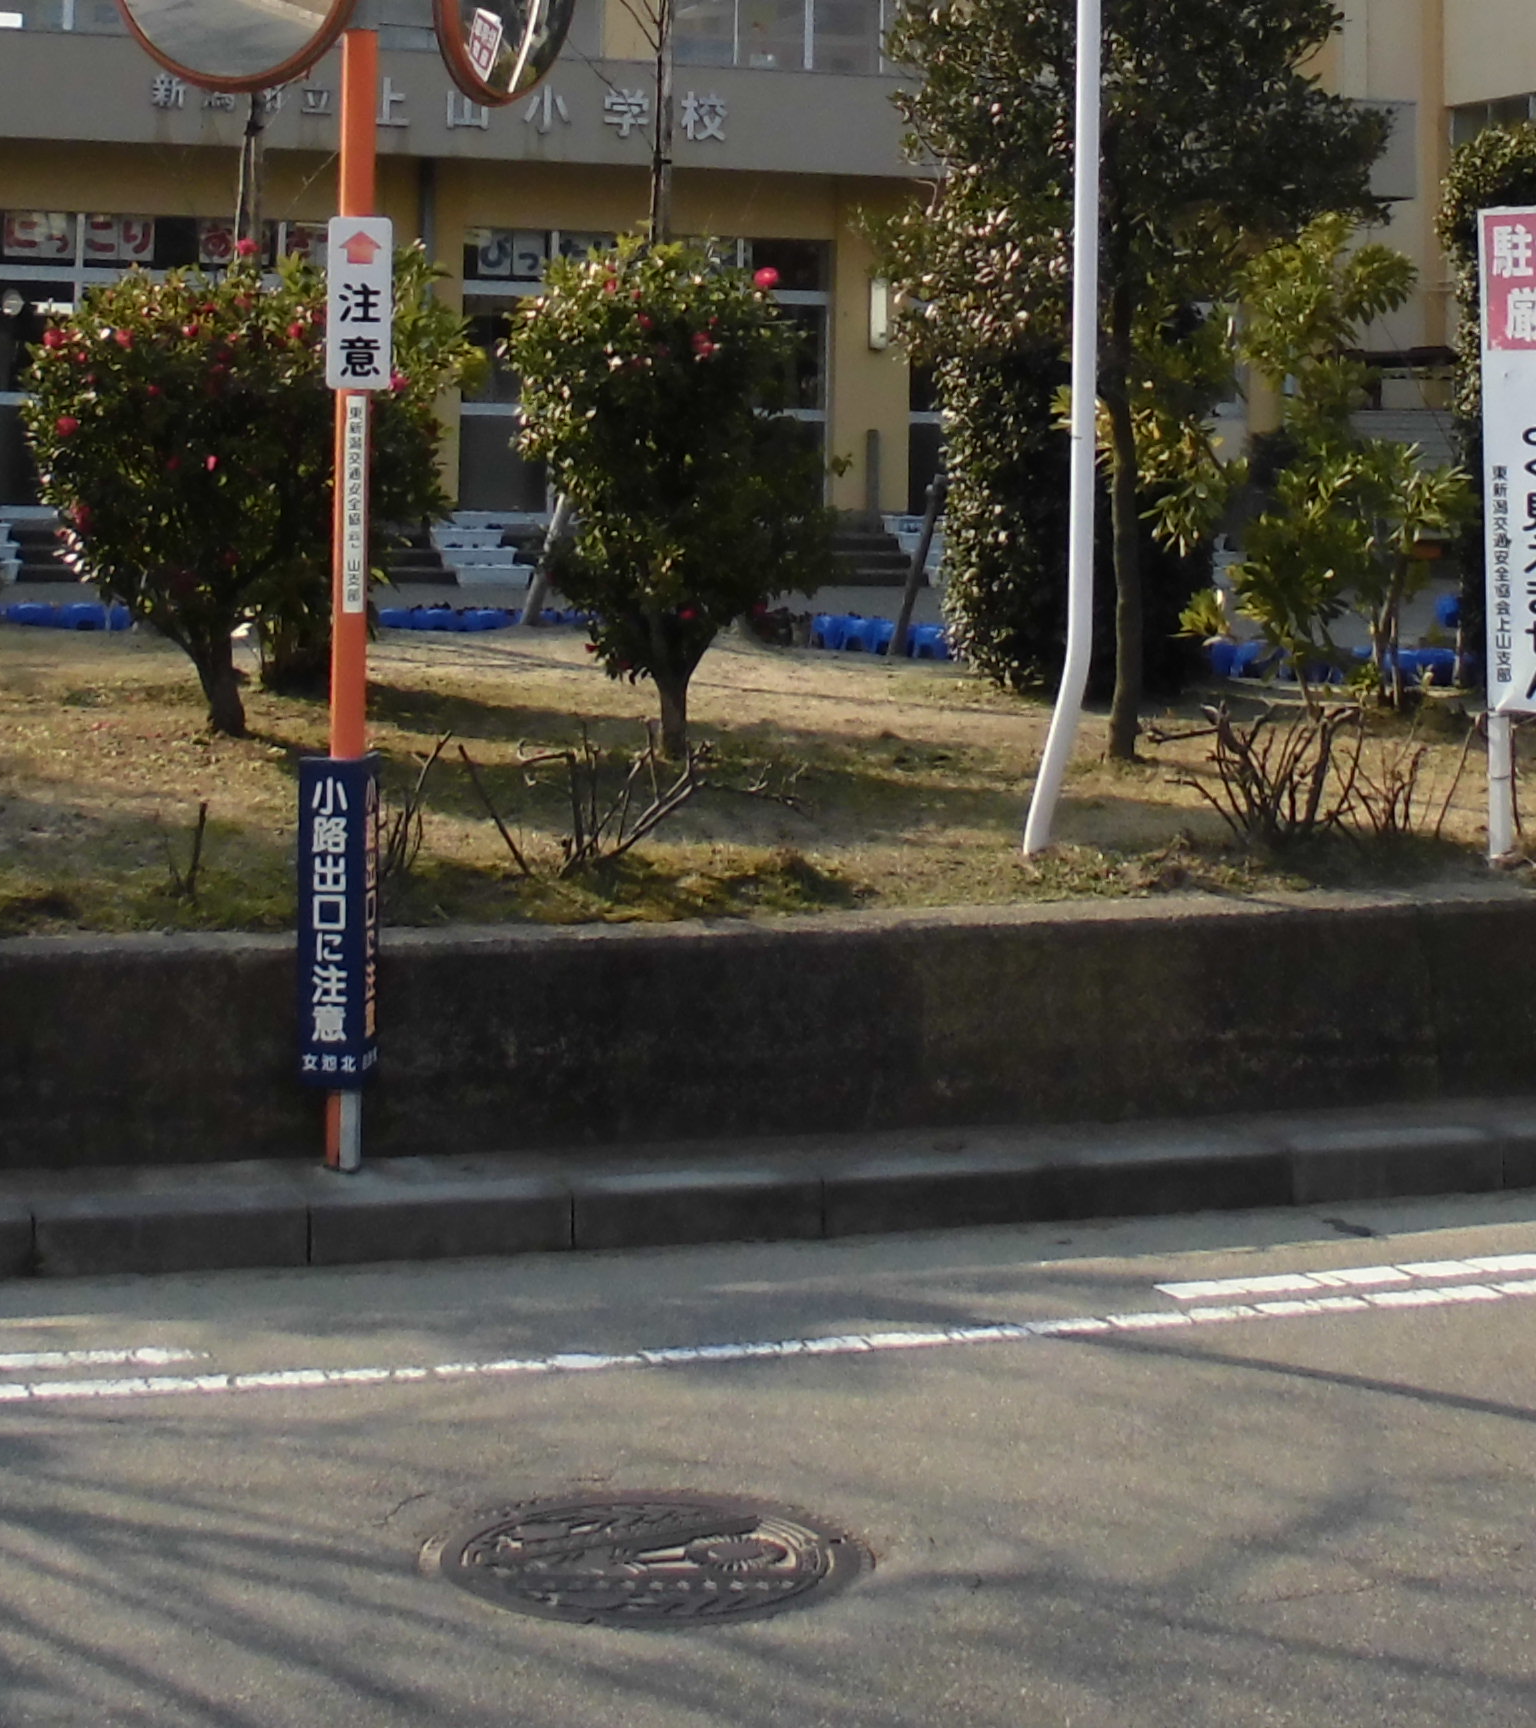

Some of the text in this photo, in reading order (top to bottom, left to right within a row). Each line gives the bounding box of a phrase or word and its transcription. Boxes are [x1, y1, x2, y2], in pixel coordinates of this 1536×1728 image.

[4, 216, 152, 255] にっこり
[338, 284, 381, 378] 注意
[348, 406, 362, 603] 東新潟交通安全協山支部
[1491, 465, 1512, 684] 東新潟交通安全協会上山支部
[312, 776, 348, 1042] 小路出口に注意
